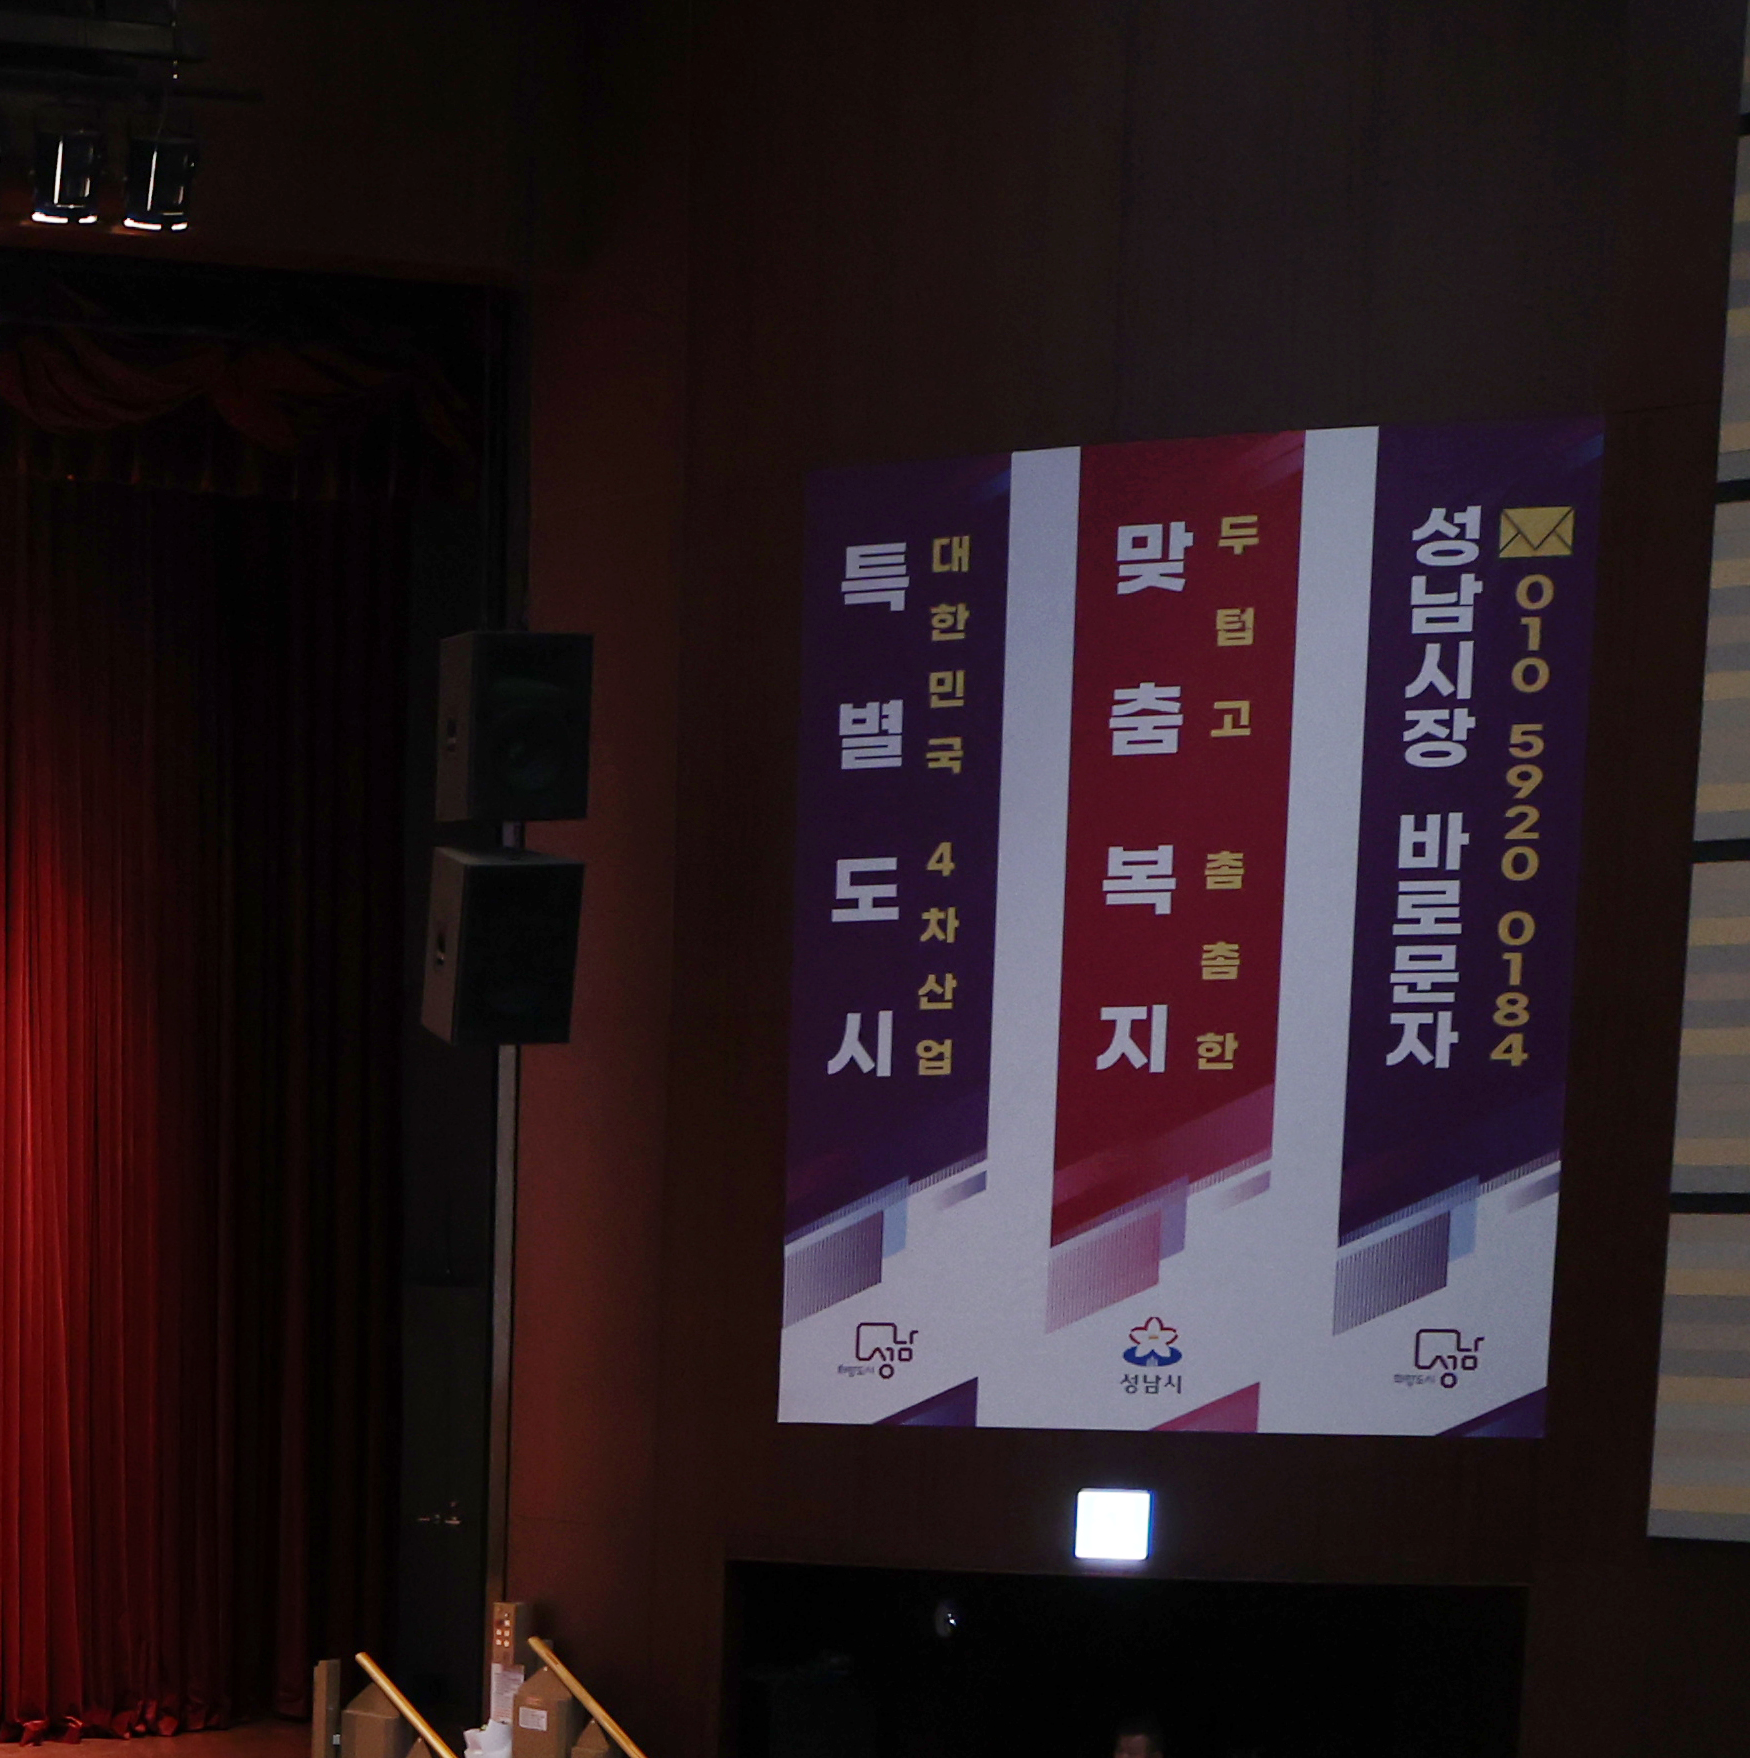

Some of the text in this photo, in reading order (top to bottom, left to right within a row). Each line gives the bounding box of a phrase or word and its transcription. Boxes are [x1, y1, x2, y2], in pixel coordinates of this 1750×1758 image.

[1385, 505, 1484, 1070] 성남시장 바로문자
[1490, 574, 1554, 1067] 010 5920 0184
[1120, 1374, 1183, 1394] 성남시
